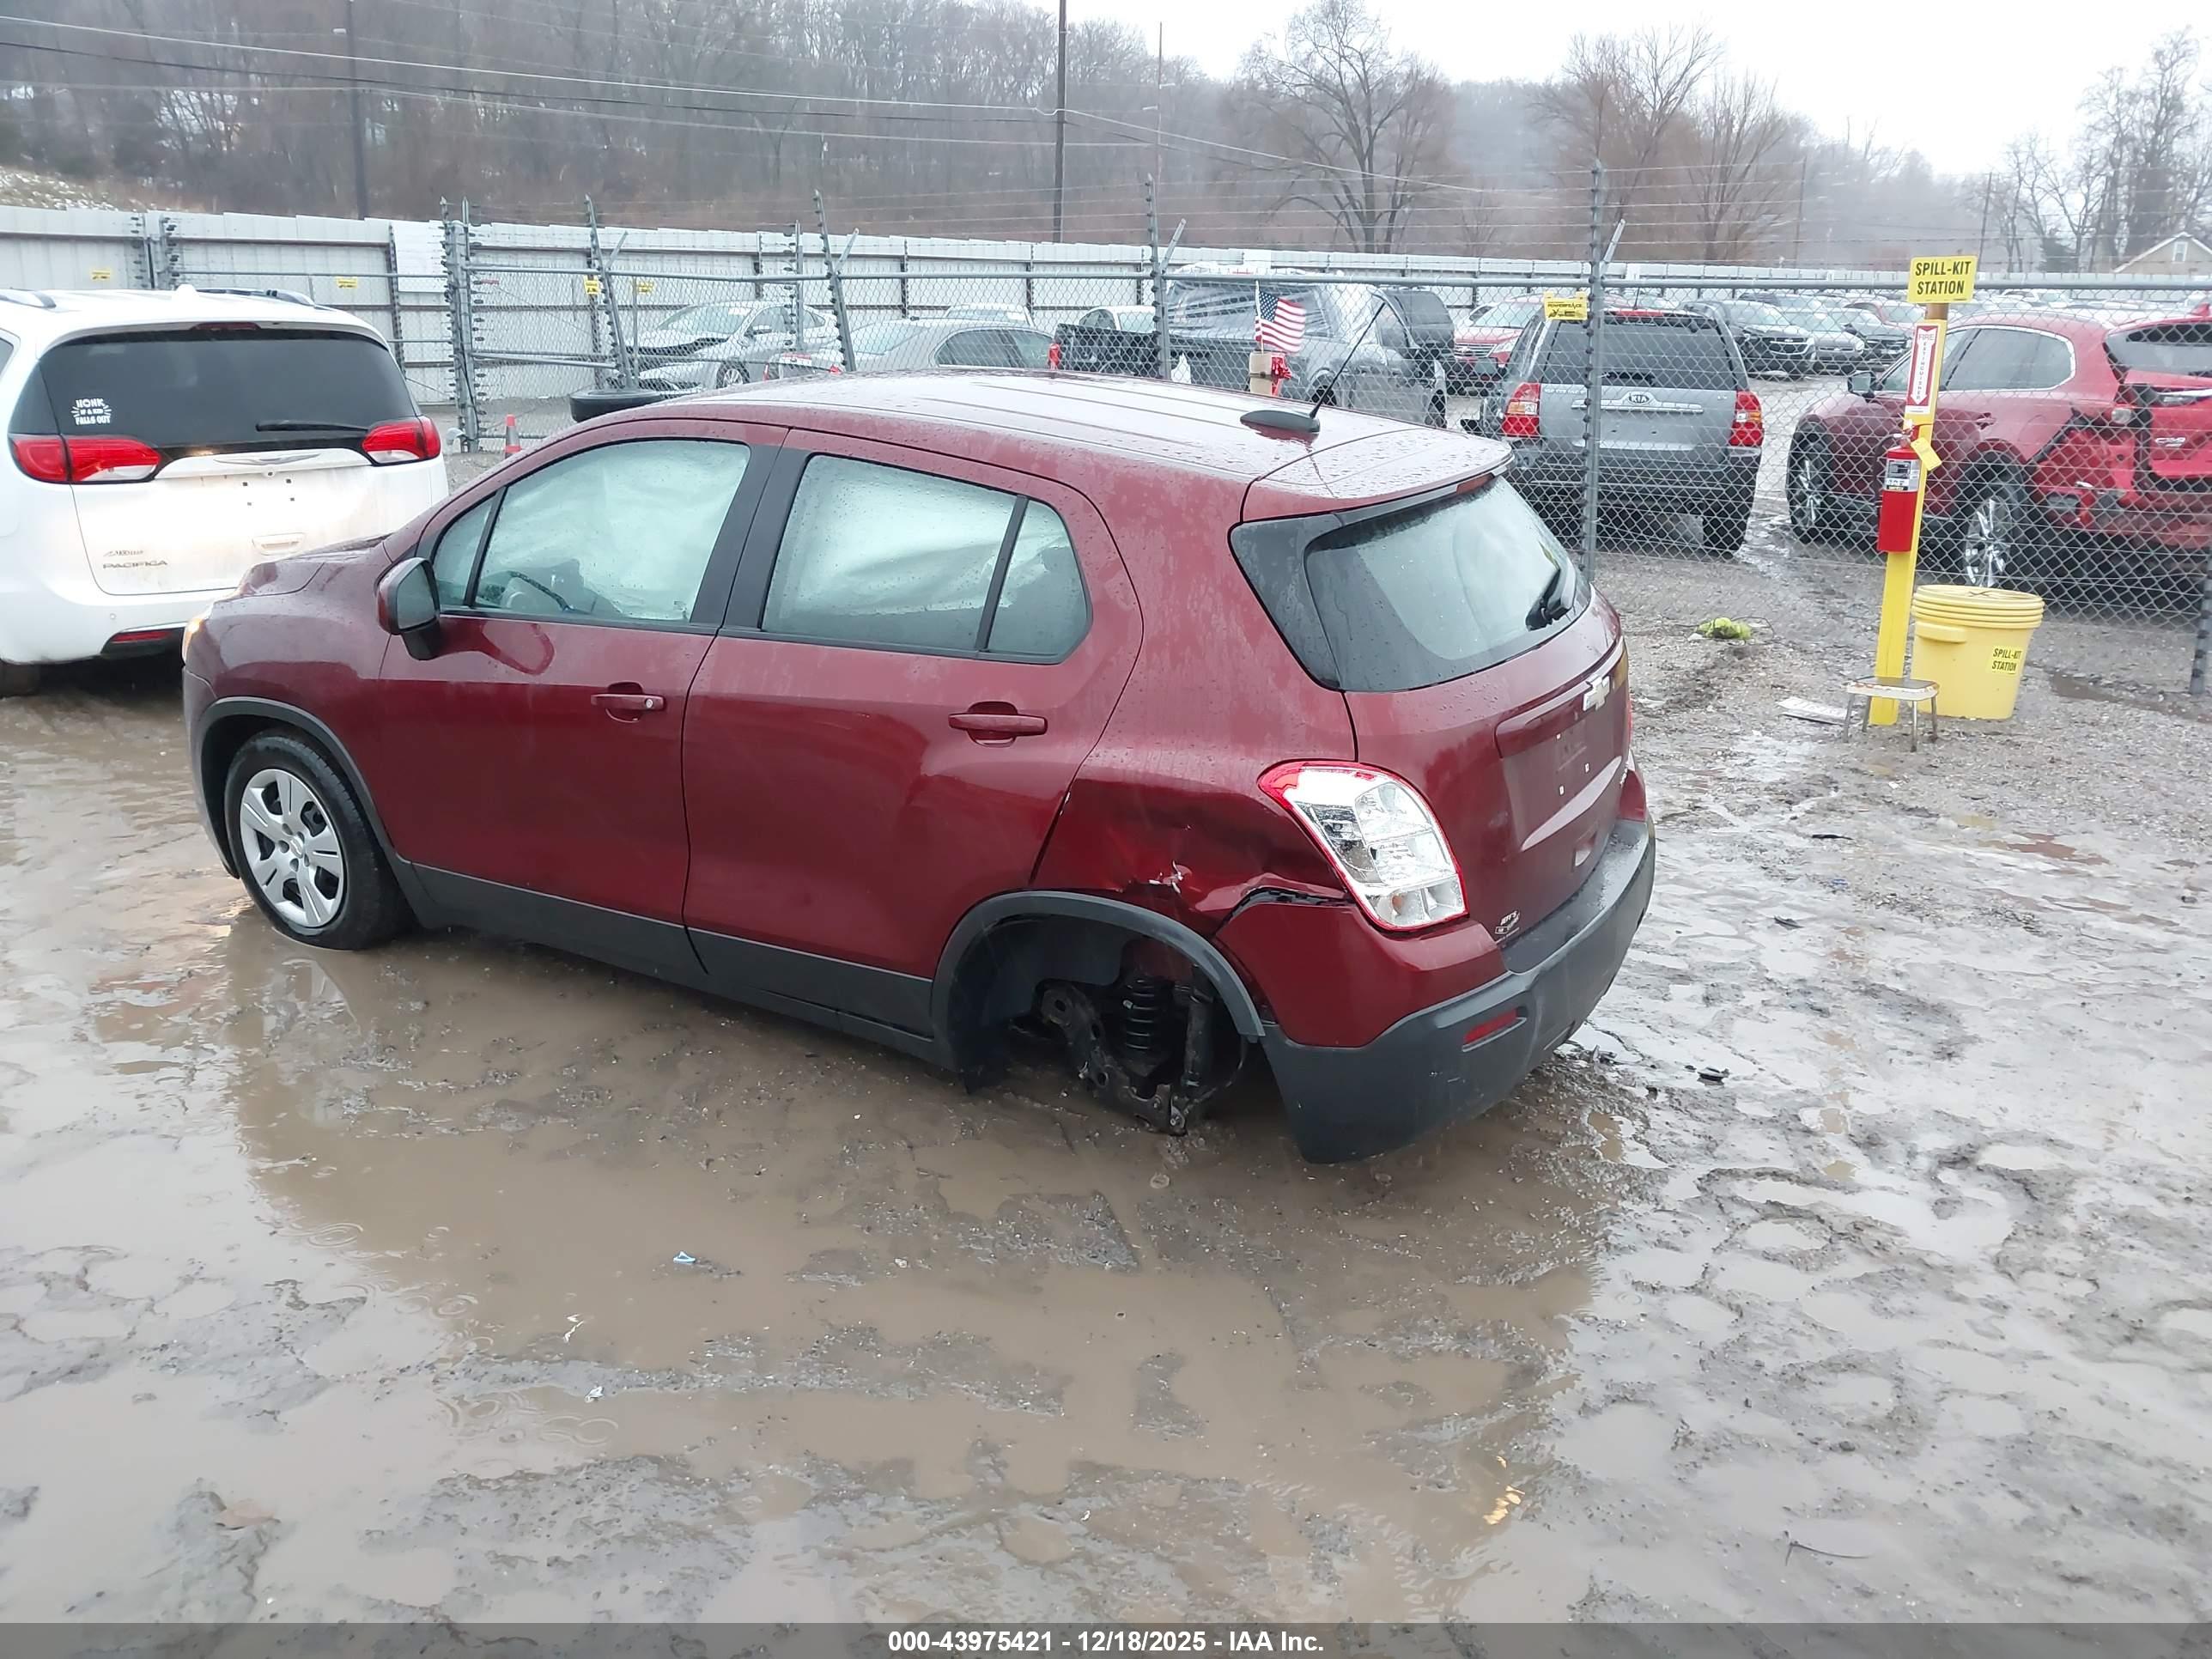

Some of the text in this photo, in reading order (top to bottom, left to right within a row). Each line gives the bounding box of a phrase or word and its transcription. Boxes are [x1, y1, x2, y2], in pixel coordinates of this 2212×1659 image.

[1915, 261, 1972, 276] SPILL-KIT
[1917, 280, 1965, 295] STATION
[76, 398, 106, 408] HONK
[75, 415, 111, 425] FALLS OUT
[103, 560, 167, 568] PACIFICA
[1993, 648, 2021, 659] SPILL-KIT
[1992, 660, 2017, 671] STATION
